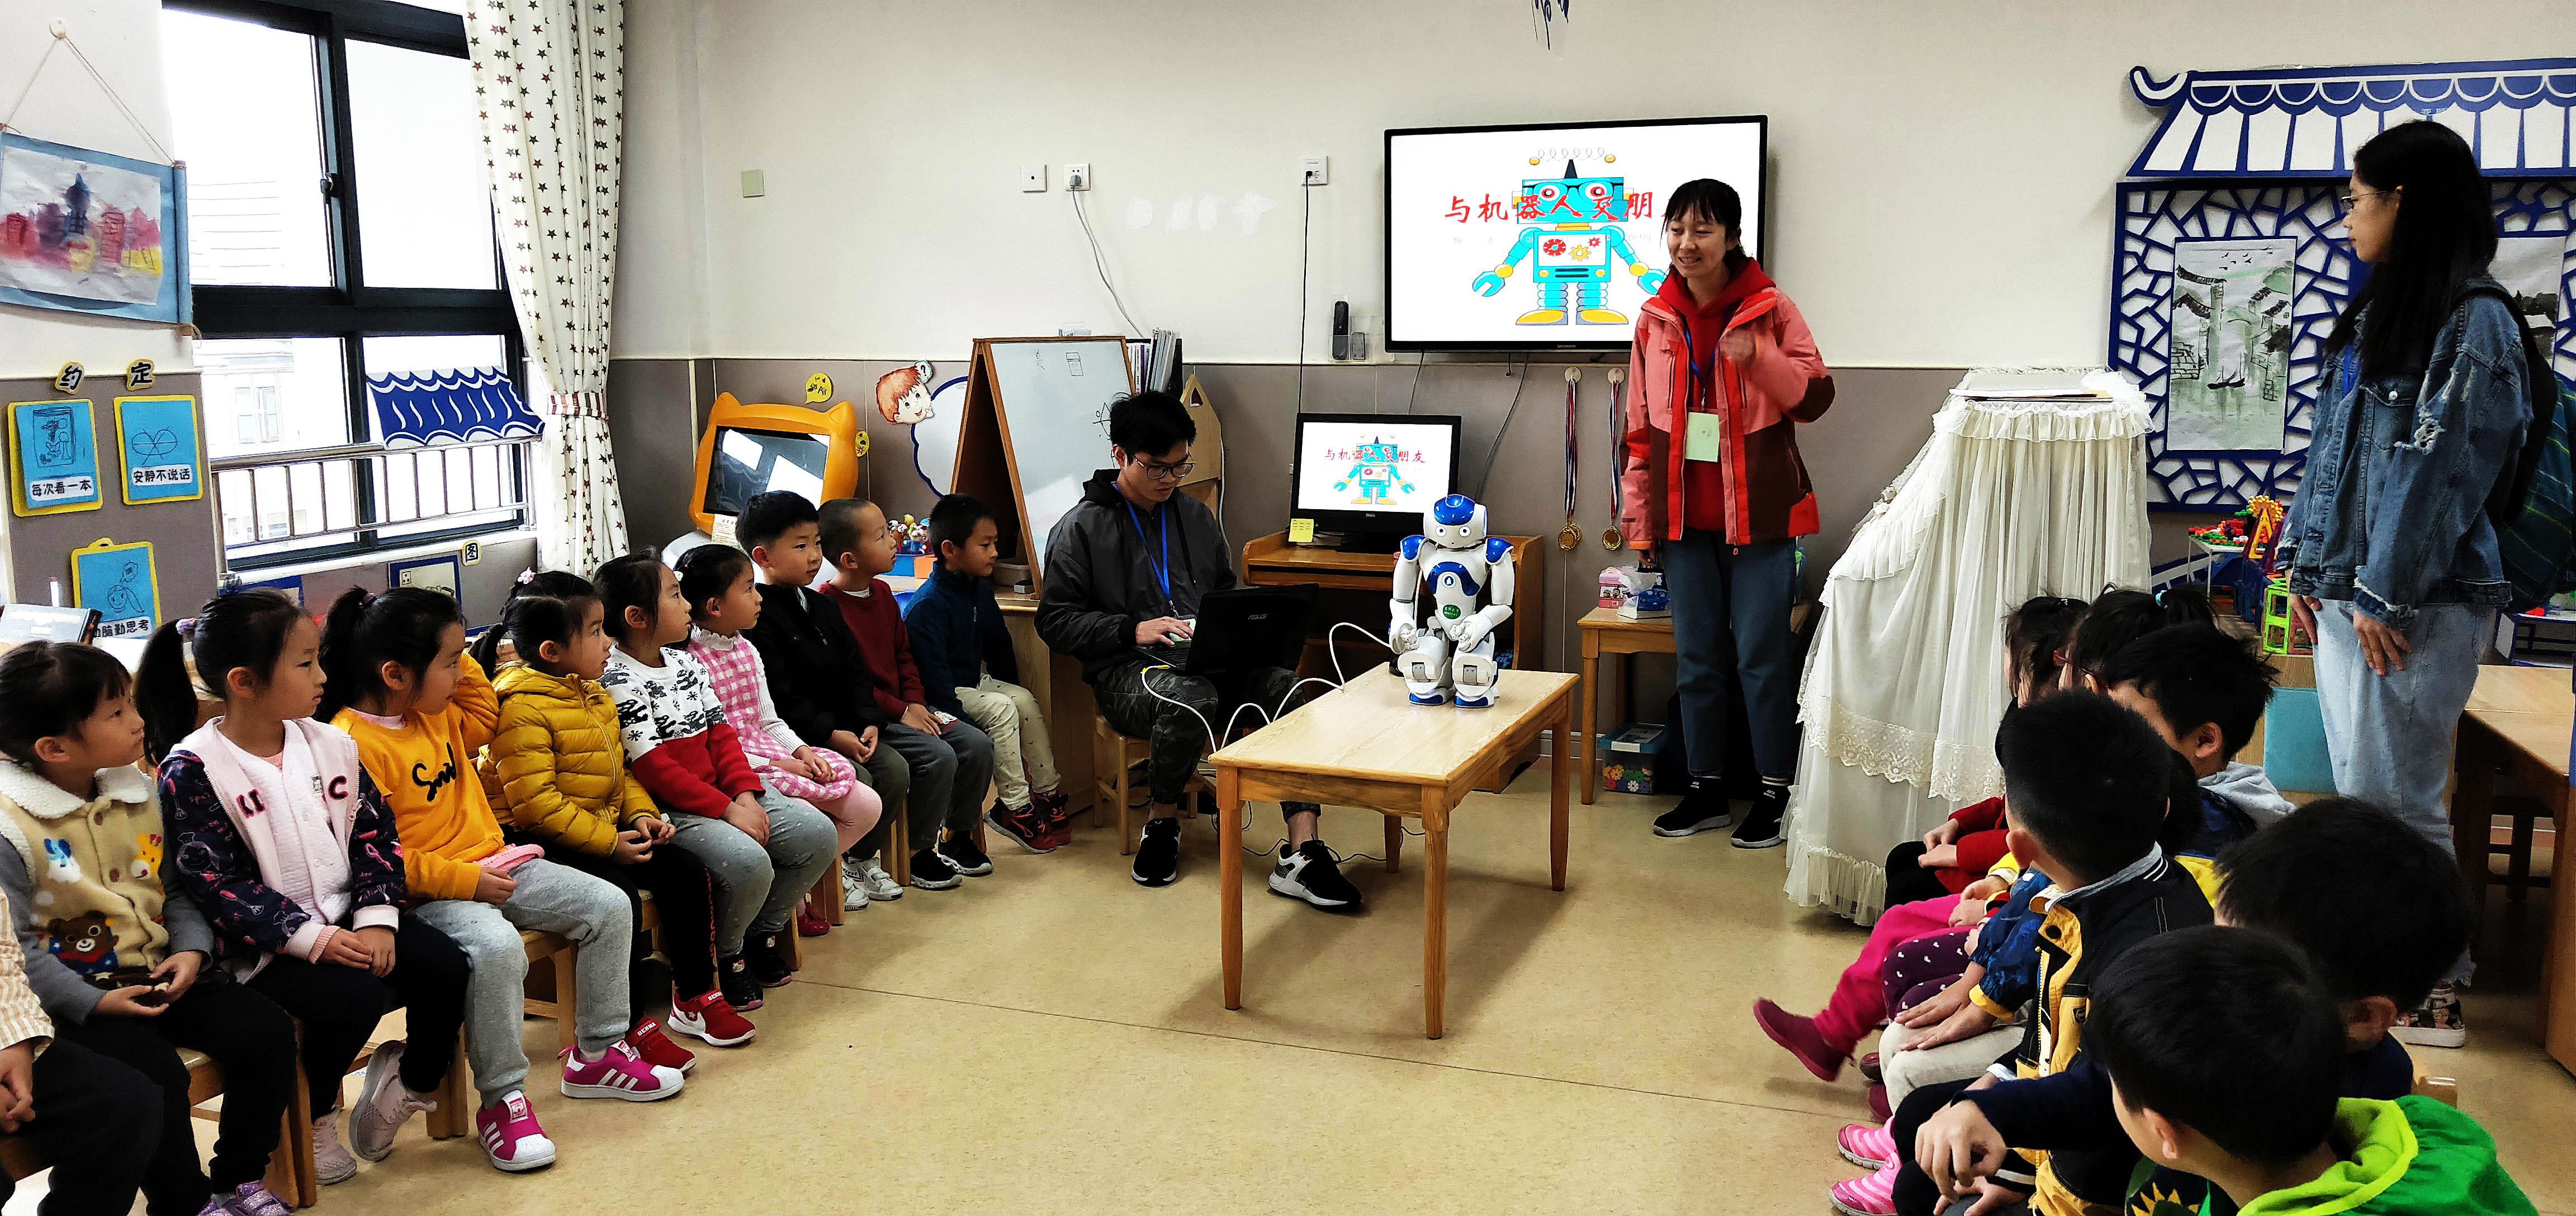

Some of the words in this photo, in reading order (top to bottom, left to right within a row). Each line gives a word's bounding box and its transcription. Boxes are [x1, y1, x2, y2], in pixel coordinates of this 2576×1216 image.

[1445, 192, 1669, 222] 与机器人交朋
[1324, 448, 1426, 463] 与机器人交朋友
[133, 468, 191, 484] 安静不说话
[32, 479, 92, 497] 每次看一本
